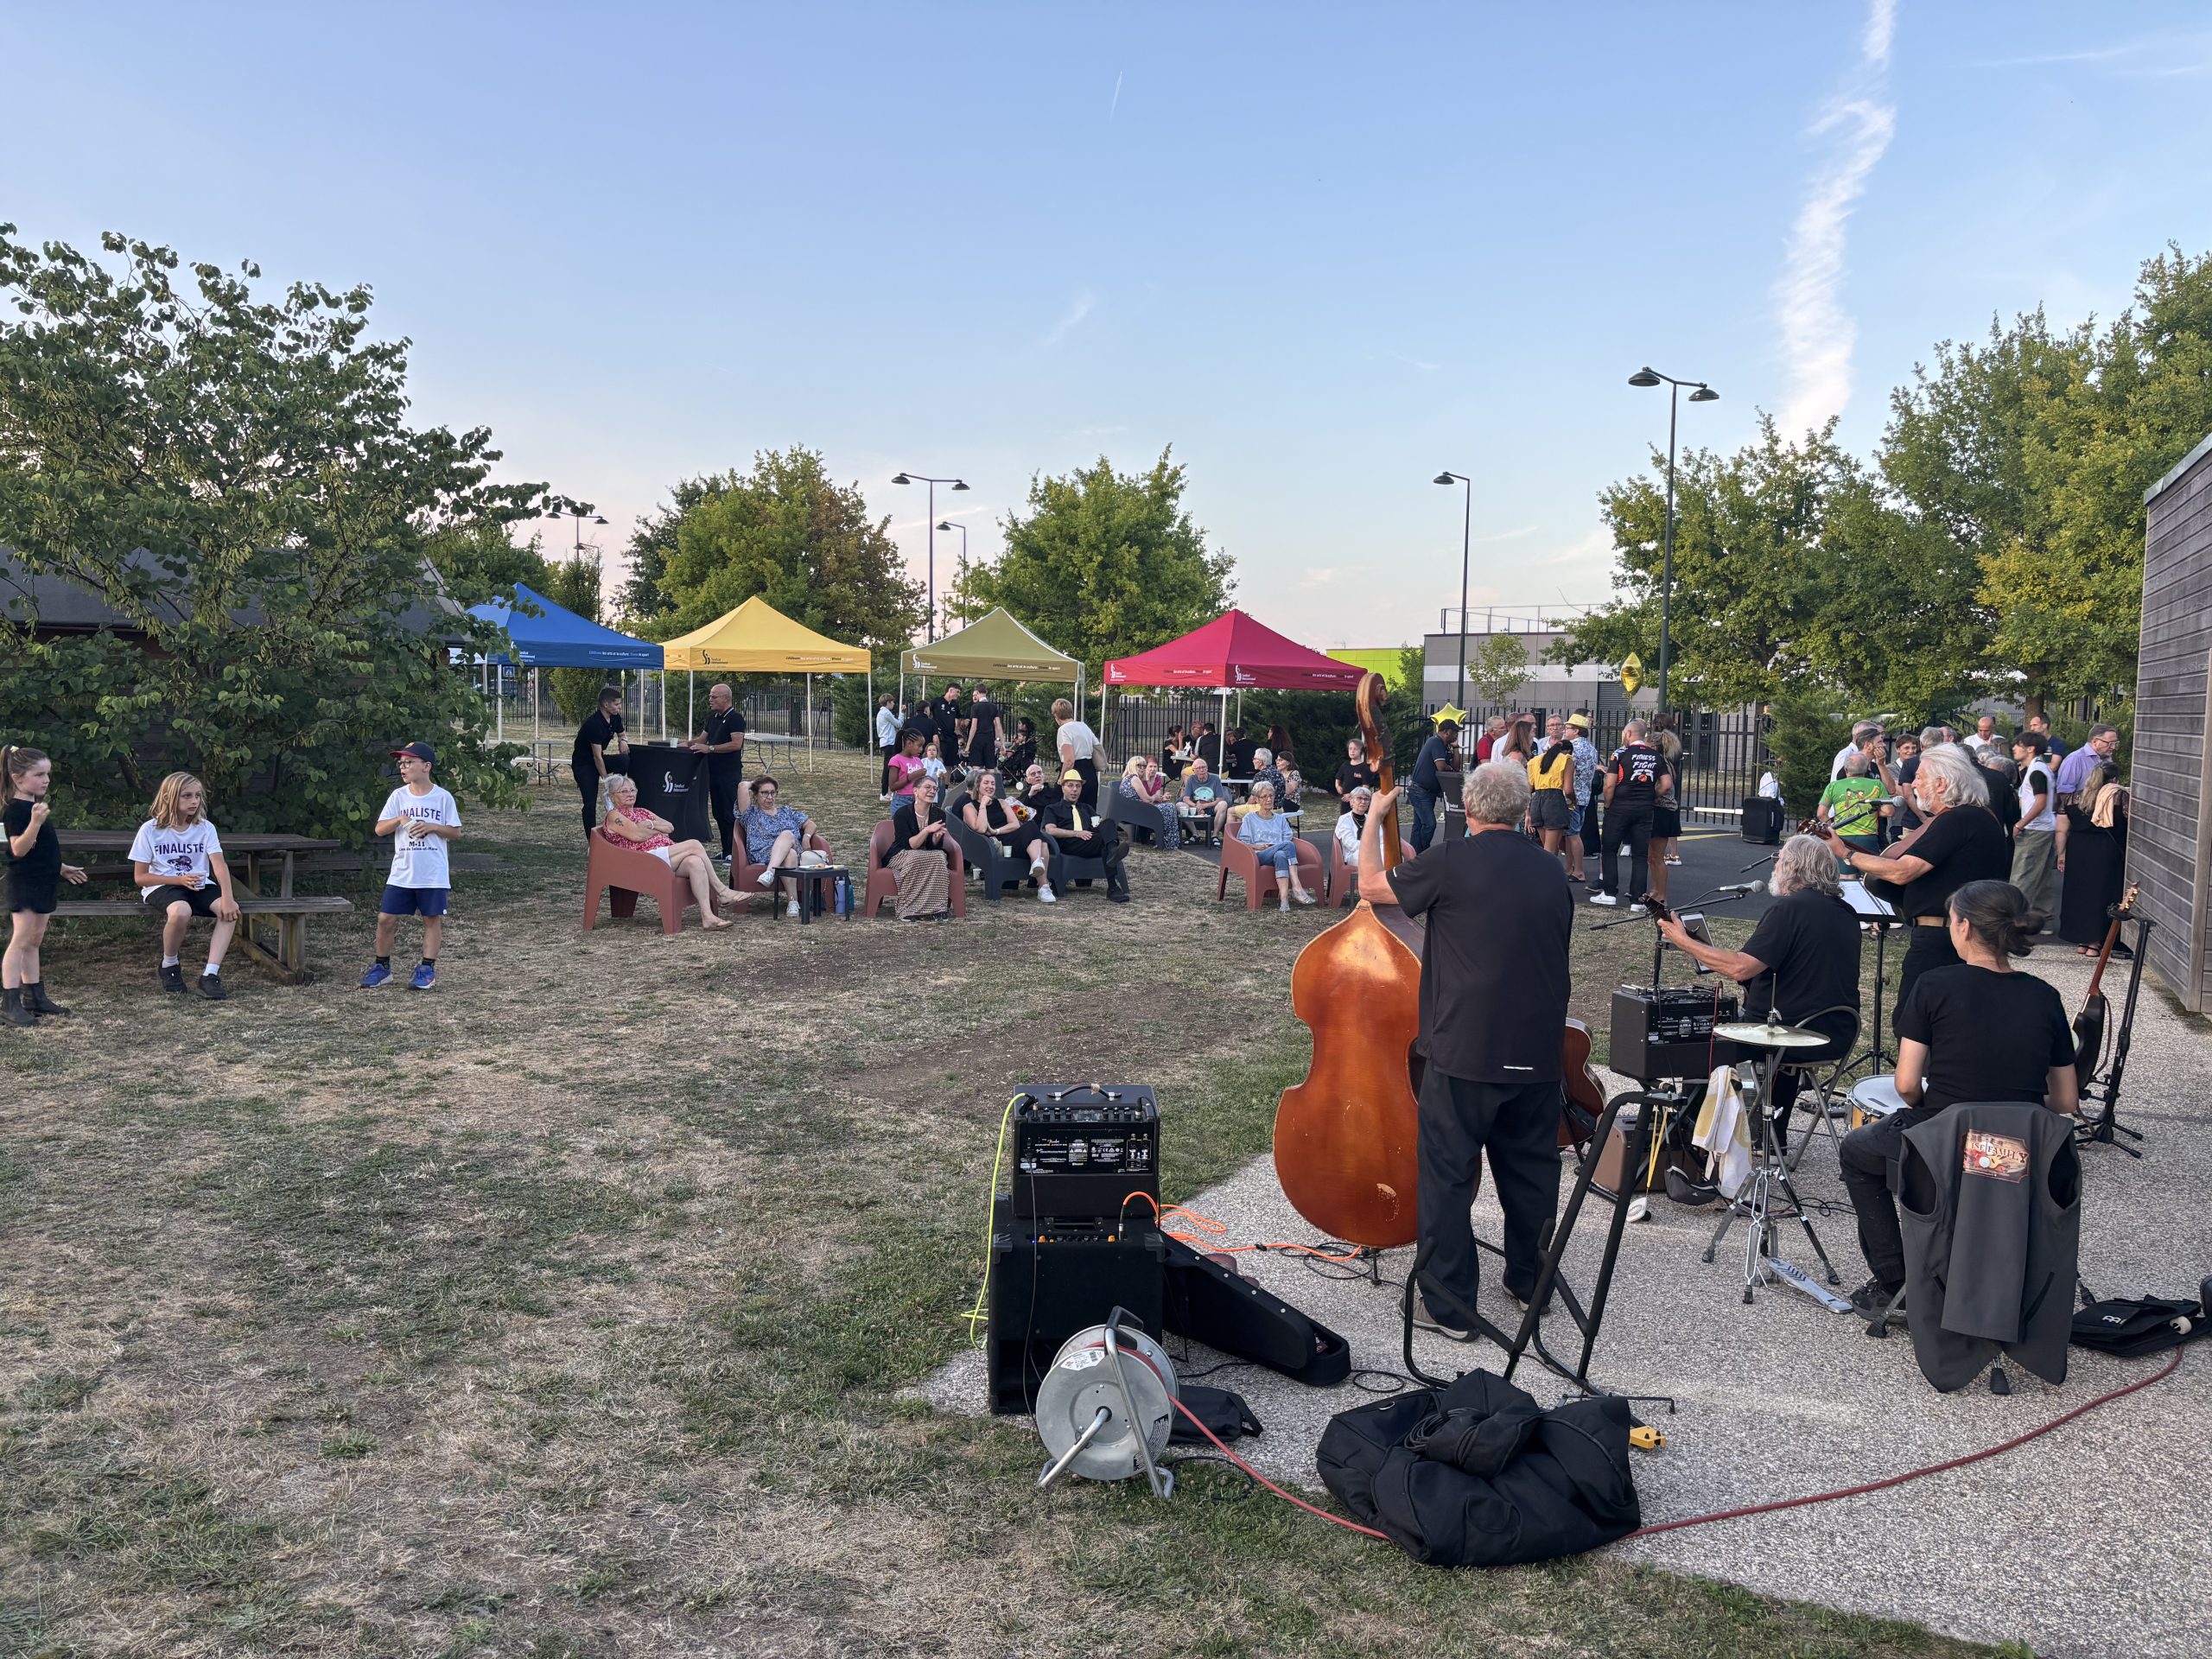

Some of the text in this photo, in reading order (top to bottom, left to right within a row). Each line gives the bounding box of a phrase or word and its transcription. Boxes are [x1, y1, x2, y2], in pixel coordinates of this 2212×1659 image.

[400, 807, 442, 821] INALISTE
[154, 842, 204, 855] FINALISTE
[1987, 1146, 2029, 1163] FAMILY
